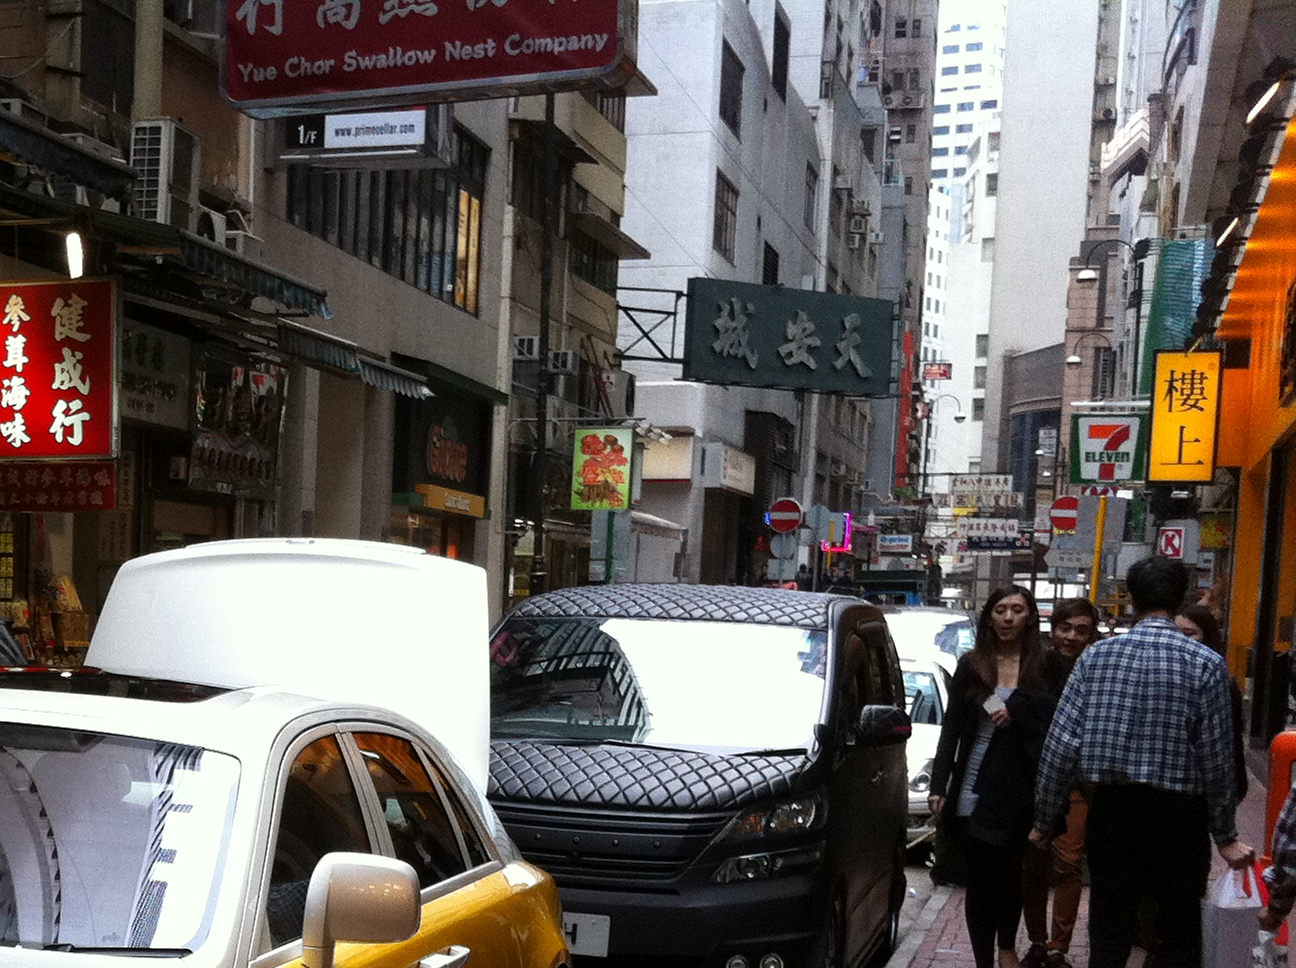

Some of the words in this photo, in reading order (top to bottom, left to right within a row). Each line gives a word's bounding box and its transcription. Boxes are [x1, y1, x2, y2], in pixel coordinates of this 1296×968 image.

[238, 63, 277, 83] Yue
[284, 56, 335, 78] Chor
[343, 46, 436, 71] Swallow
[444, 39, 496, 62] Nest
[504, 33, 608, 57] Company
[298, 124, 317, 144] 1/F
[0, 294, 32, 448] 參茸海味
[49, 293, 92, 446] 健成行
[1160, 369, 1208, 466] 樓上
